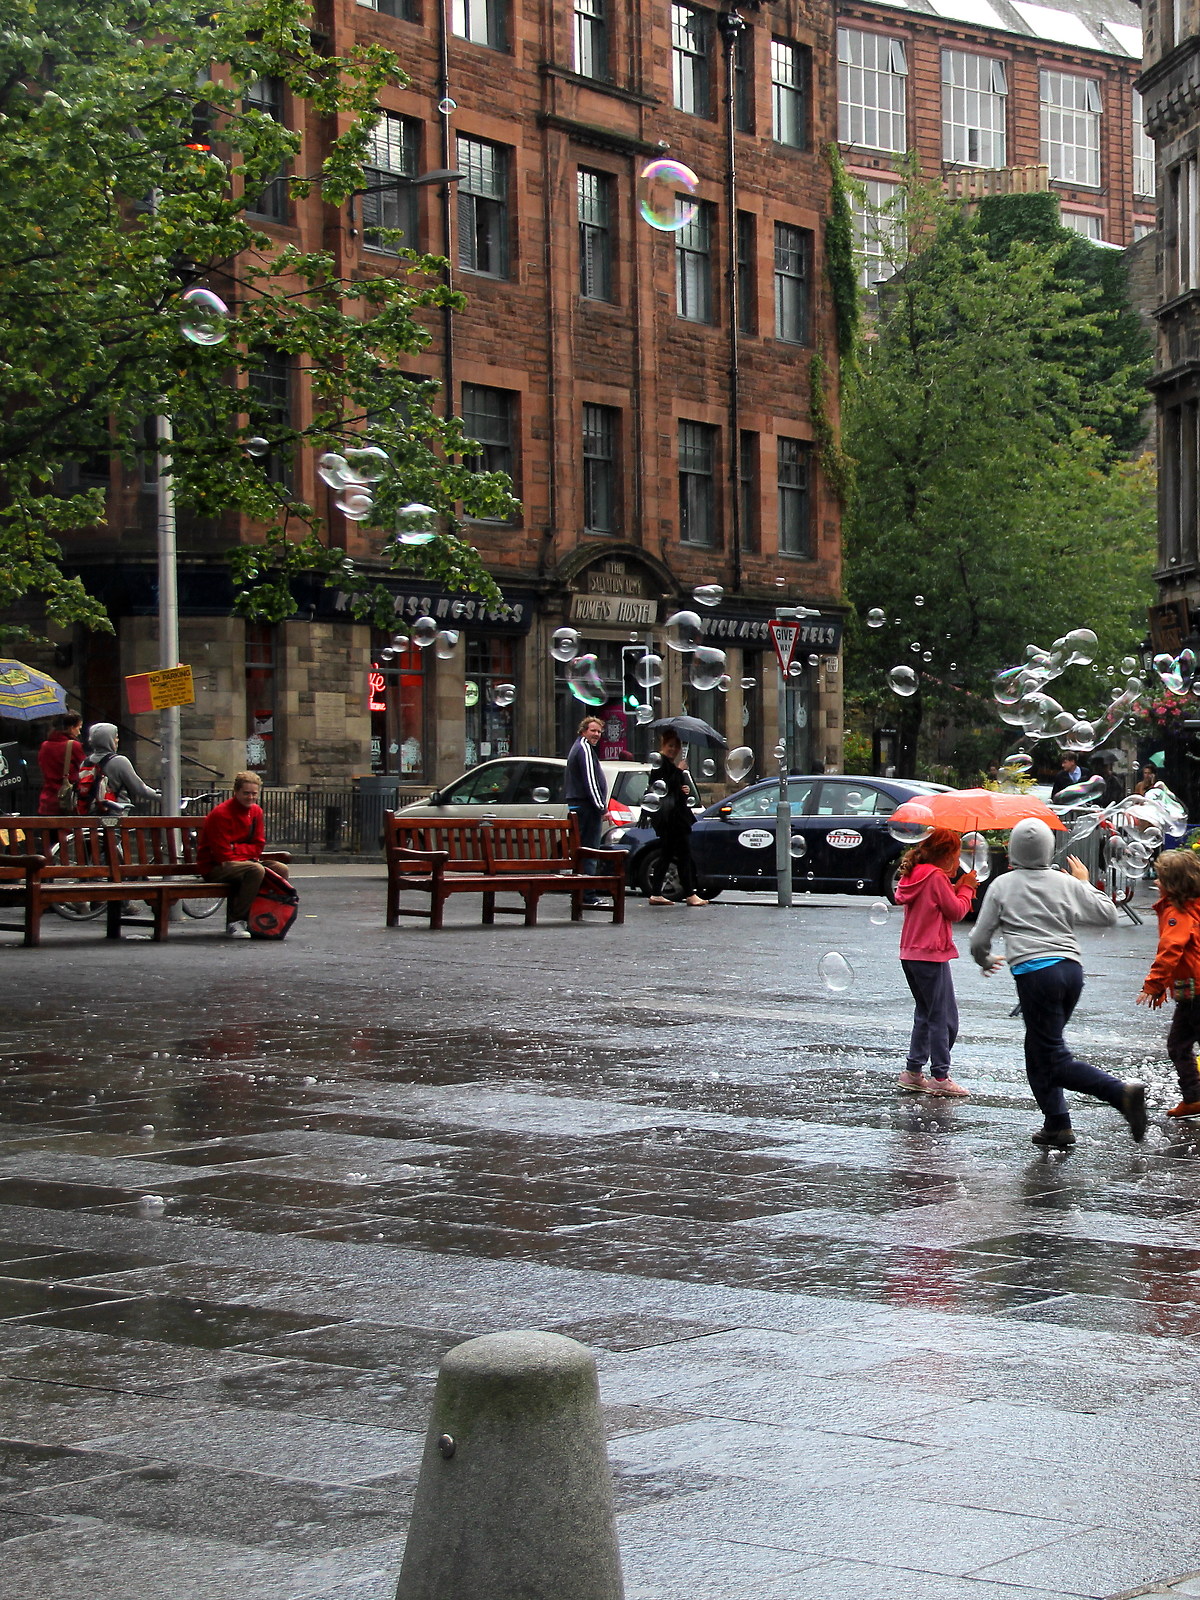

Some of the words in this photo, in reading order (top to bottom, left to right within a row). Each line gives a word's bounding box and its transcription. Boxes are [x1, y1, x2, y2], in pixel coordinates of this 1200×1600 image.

[393, 595, 431, 616] ASS
[618, 602, 653, 624] HOSTEL
[700, 617, 738, 637] KICK
[740, 621, 769, 640] ASS
[776, 628, 793, 641] GIVE
[780, 644, 791, 652] WAY
[150, 676, 160, 684] NO
[163, 669, 191, 681] PARKING
[828, 835, 860, 844] 777-7777
